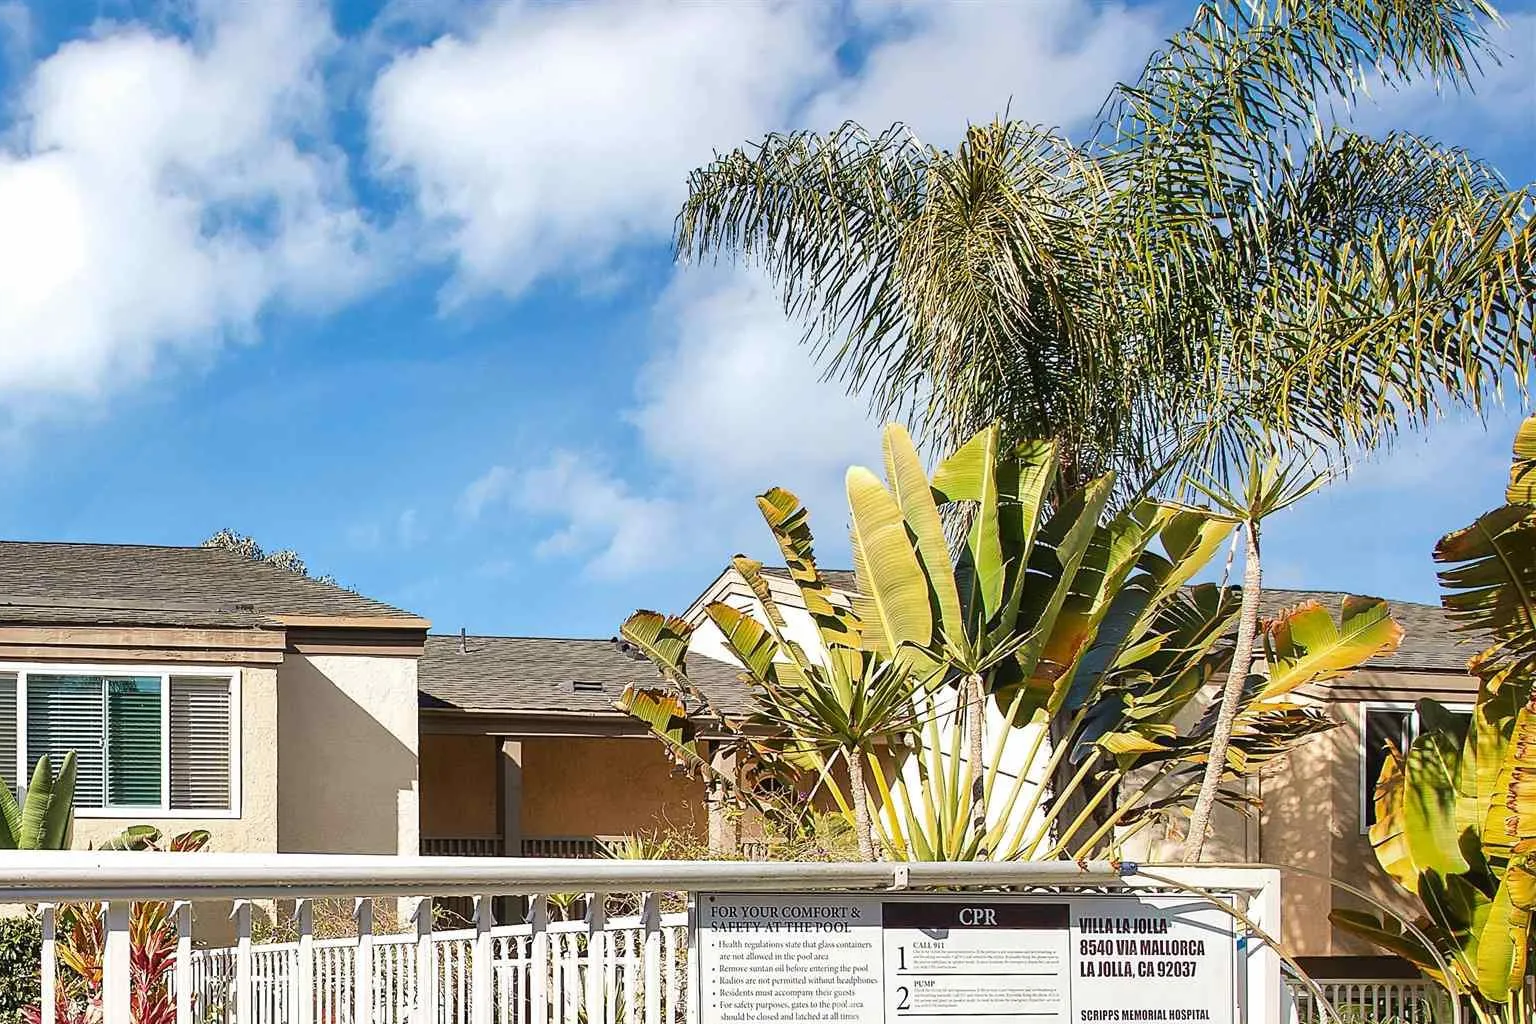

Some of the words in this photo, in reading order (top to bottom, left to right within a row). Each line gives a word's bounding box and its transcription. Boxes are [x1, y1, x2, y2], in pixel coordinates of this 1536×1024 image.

[711, 907, 737, 918] FOR
[741, 907, 778, 918] YOUR
[782, 907, 848, 918] COMFORT
[851, 907, 860, 918] &
[959, 908, 997, 925] CPR
[711, 922, 760, 932] SAFETY
[764, 922, 781, 932] AT
[785, 922, 812, 932] THE
[816, 922, 851, 933] POOL
[1080, 918, 1113, 934] VILLA
[1116, 918, 1130, 934] LA
[1133, 918, 1168, 934] JOLLA
[719, 940, 742, 948] Health
[745, 940, 783, 950] regulations
[802, 940, 816, 948] that
[818, 940, 834, 949] glass
[1080, 940, 1113, 955] 8540
[1117, 940, 1137, 955] VIA
[1140, 940, 1205, 955] MALLORCA
[797, 953, 812, 962] pool
[897, 947, 907, 970] 1
[786, 964, 807, 972] before
[809, 965, 838, 974] entering
[840, 964, 851, 972] the
[853, 964, 868, 973] pool
[1080, 962, 1095, 977] LA
[1098, 962, 1135, 978] JOLLA,
[1138, 962, 1154, 977] CA
[1158, 962, 1196, 977] 92037
[772, 977, 806, 986] permitted
[808, 976, 834, 984] without
[837, 976, 878, 986] headphones
[774, 990, 813, 998] accompany
[816, 988, 831, 996] their
[834, 990, 855, 998] guests
[897, 986, 910, 1010] 2
[1081, 1010, 1119, 1020] SCRIPPS
[1122, 1010, 1166, 1020] MEMORIAL
[1169, 1009, 1209, 1020] HOSPITAL
